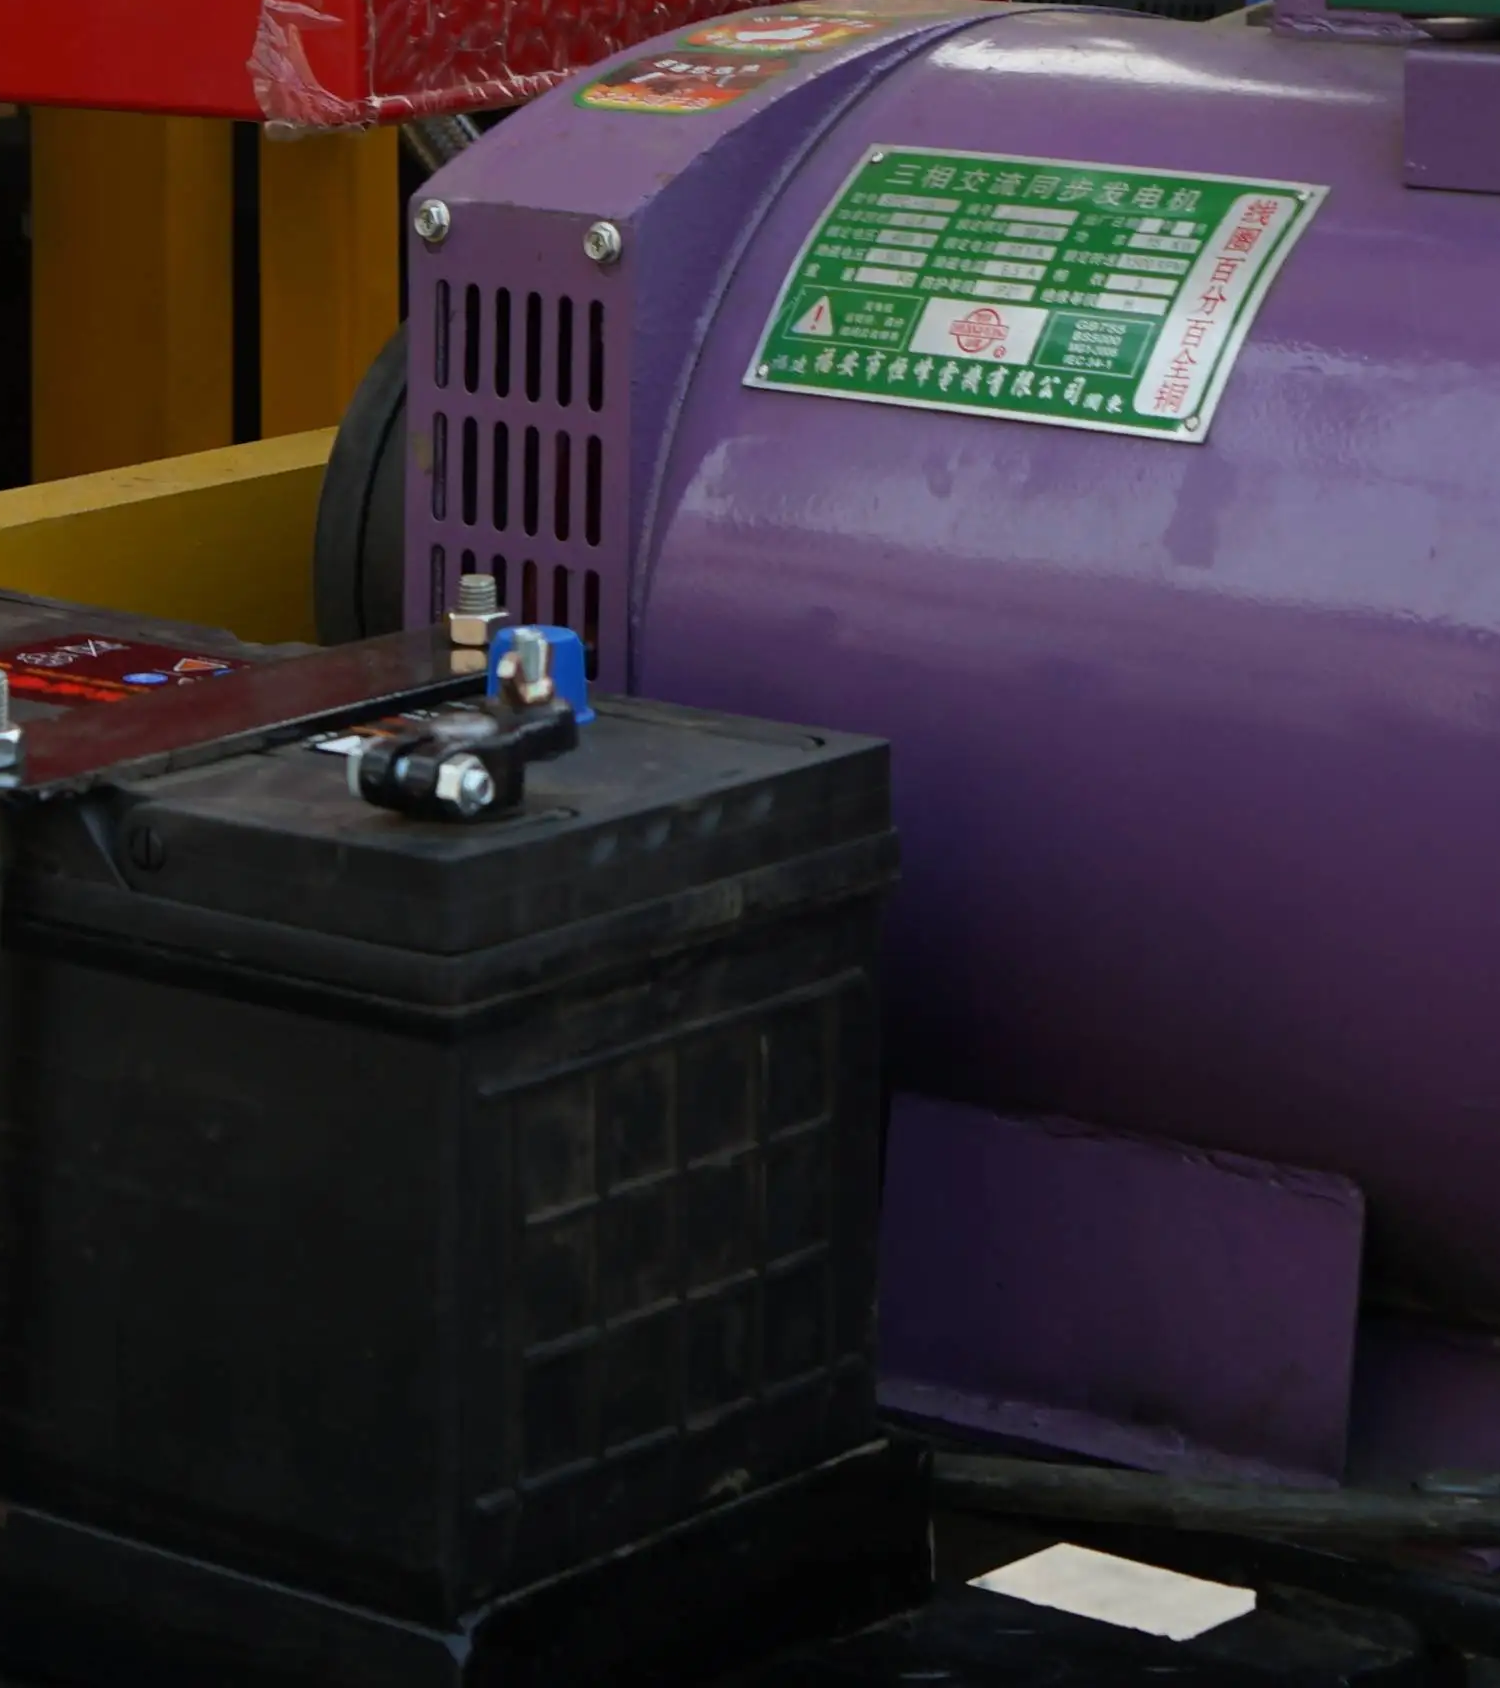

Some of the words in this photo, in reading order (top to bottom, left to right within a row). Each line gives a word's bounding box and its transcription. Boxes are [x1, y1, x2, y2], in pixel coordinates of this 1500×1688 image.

[884, 162, 1204, 213] 三相交流同步发电机
